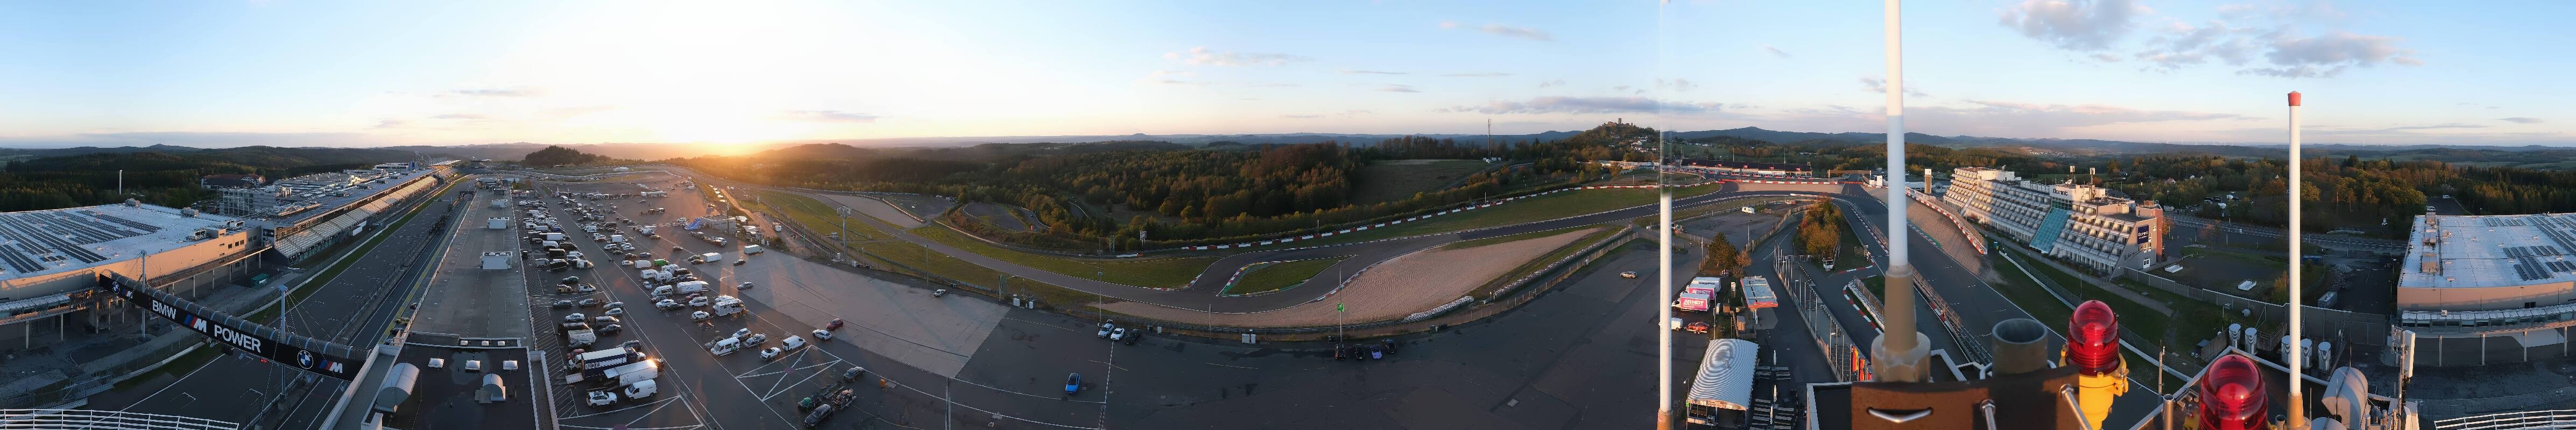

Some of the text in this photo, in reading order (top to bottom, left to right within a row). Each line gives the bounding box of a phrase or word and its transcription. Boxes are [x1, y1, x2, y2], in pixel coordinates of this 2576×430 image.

[152, 299, 261, 353] BMW M POWER
[329, 362, 343, 374] M
